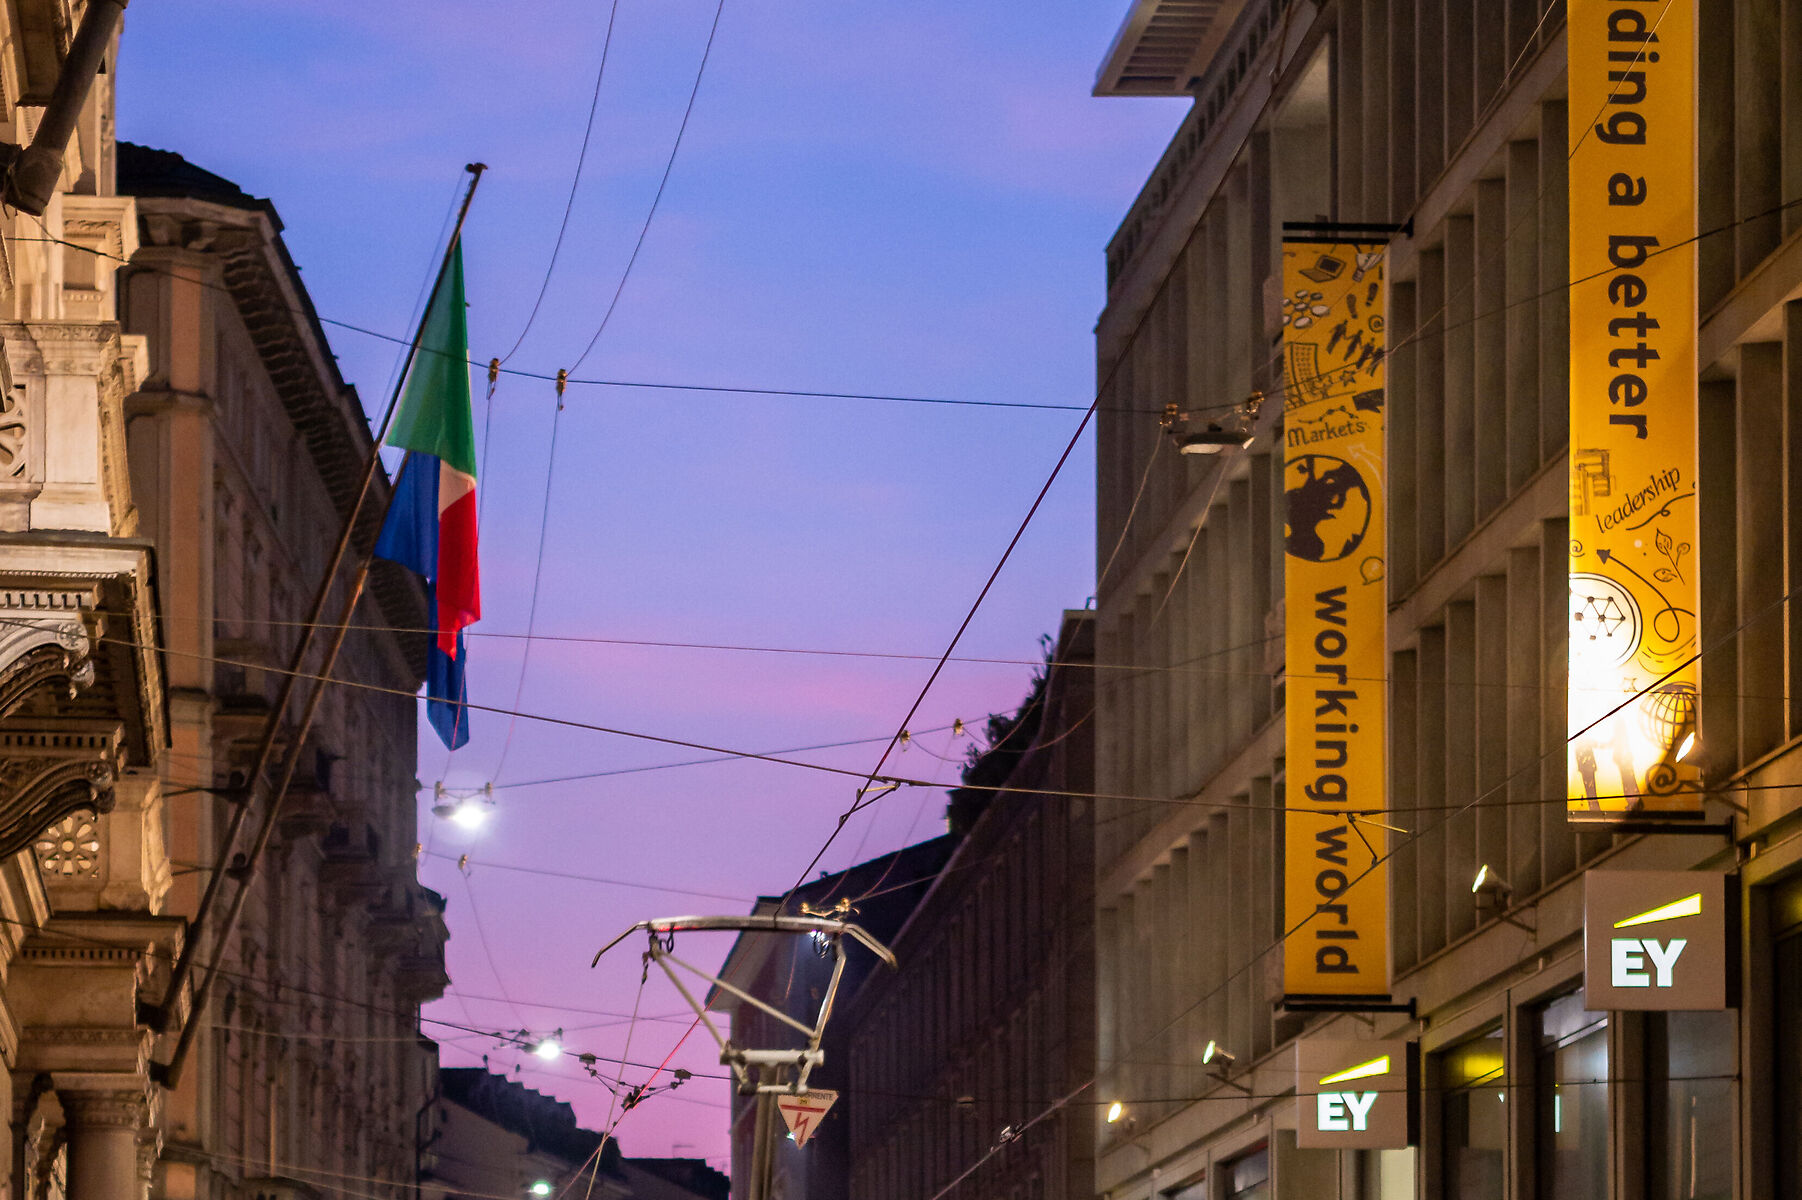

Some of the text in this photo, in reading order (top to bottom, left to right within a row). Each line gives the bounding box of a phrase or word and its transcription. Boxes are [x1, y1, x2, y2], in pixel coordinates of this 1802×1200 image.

[1595, 0, 1661, 440] ding a better
[1287, 420, 1366, 448] Markets
[1595, 466, 1681, 534] leadership
[1304, 585, 1360, 974] working world
[1611, 938, 1688, 988] EY
[1317, 1090, 1379, 1131] EY
